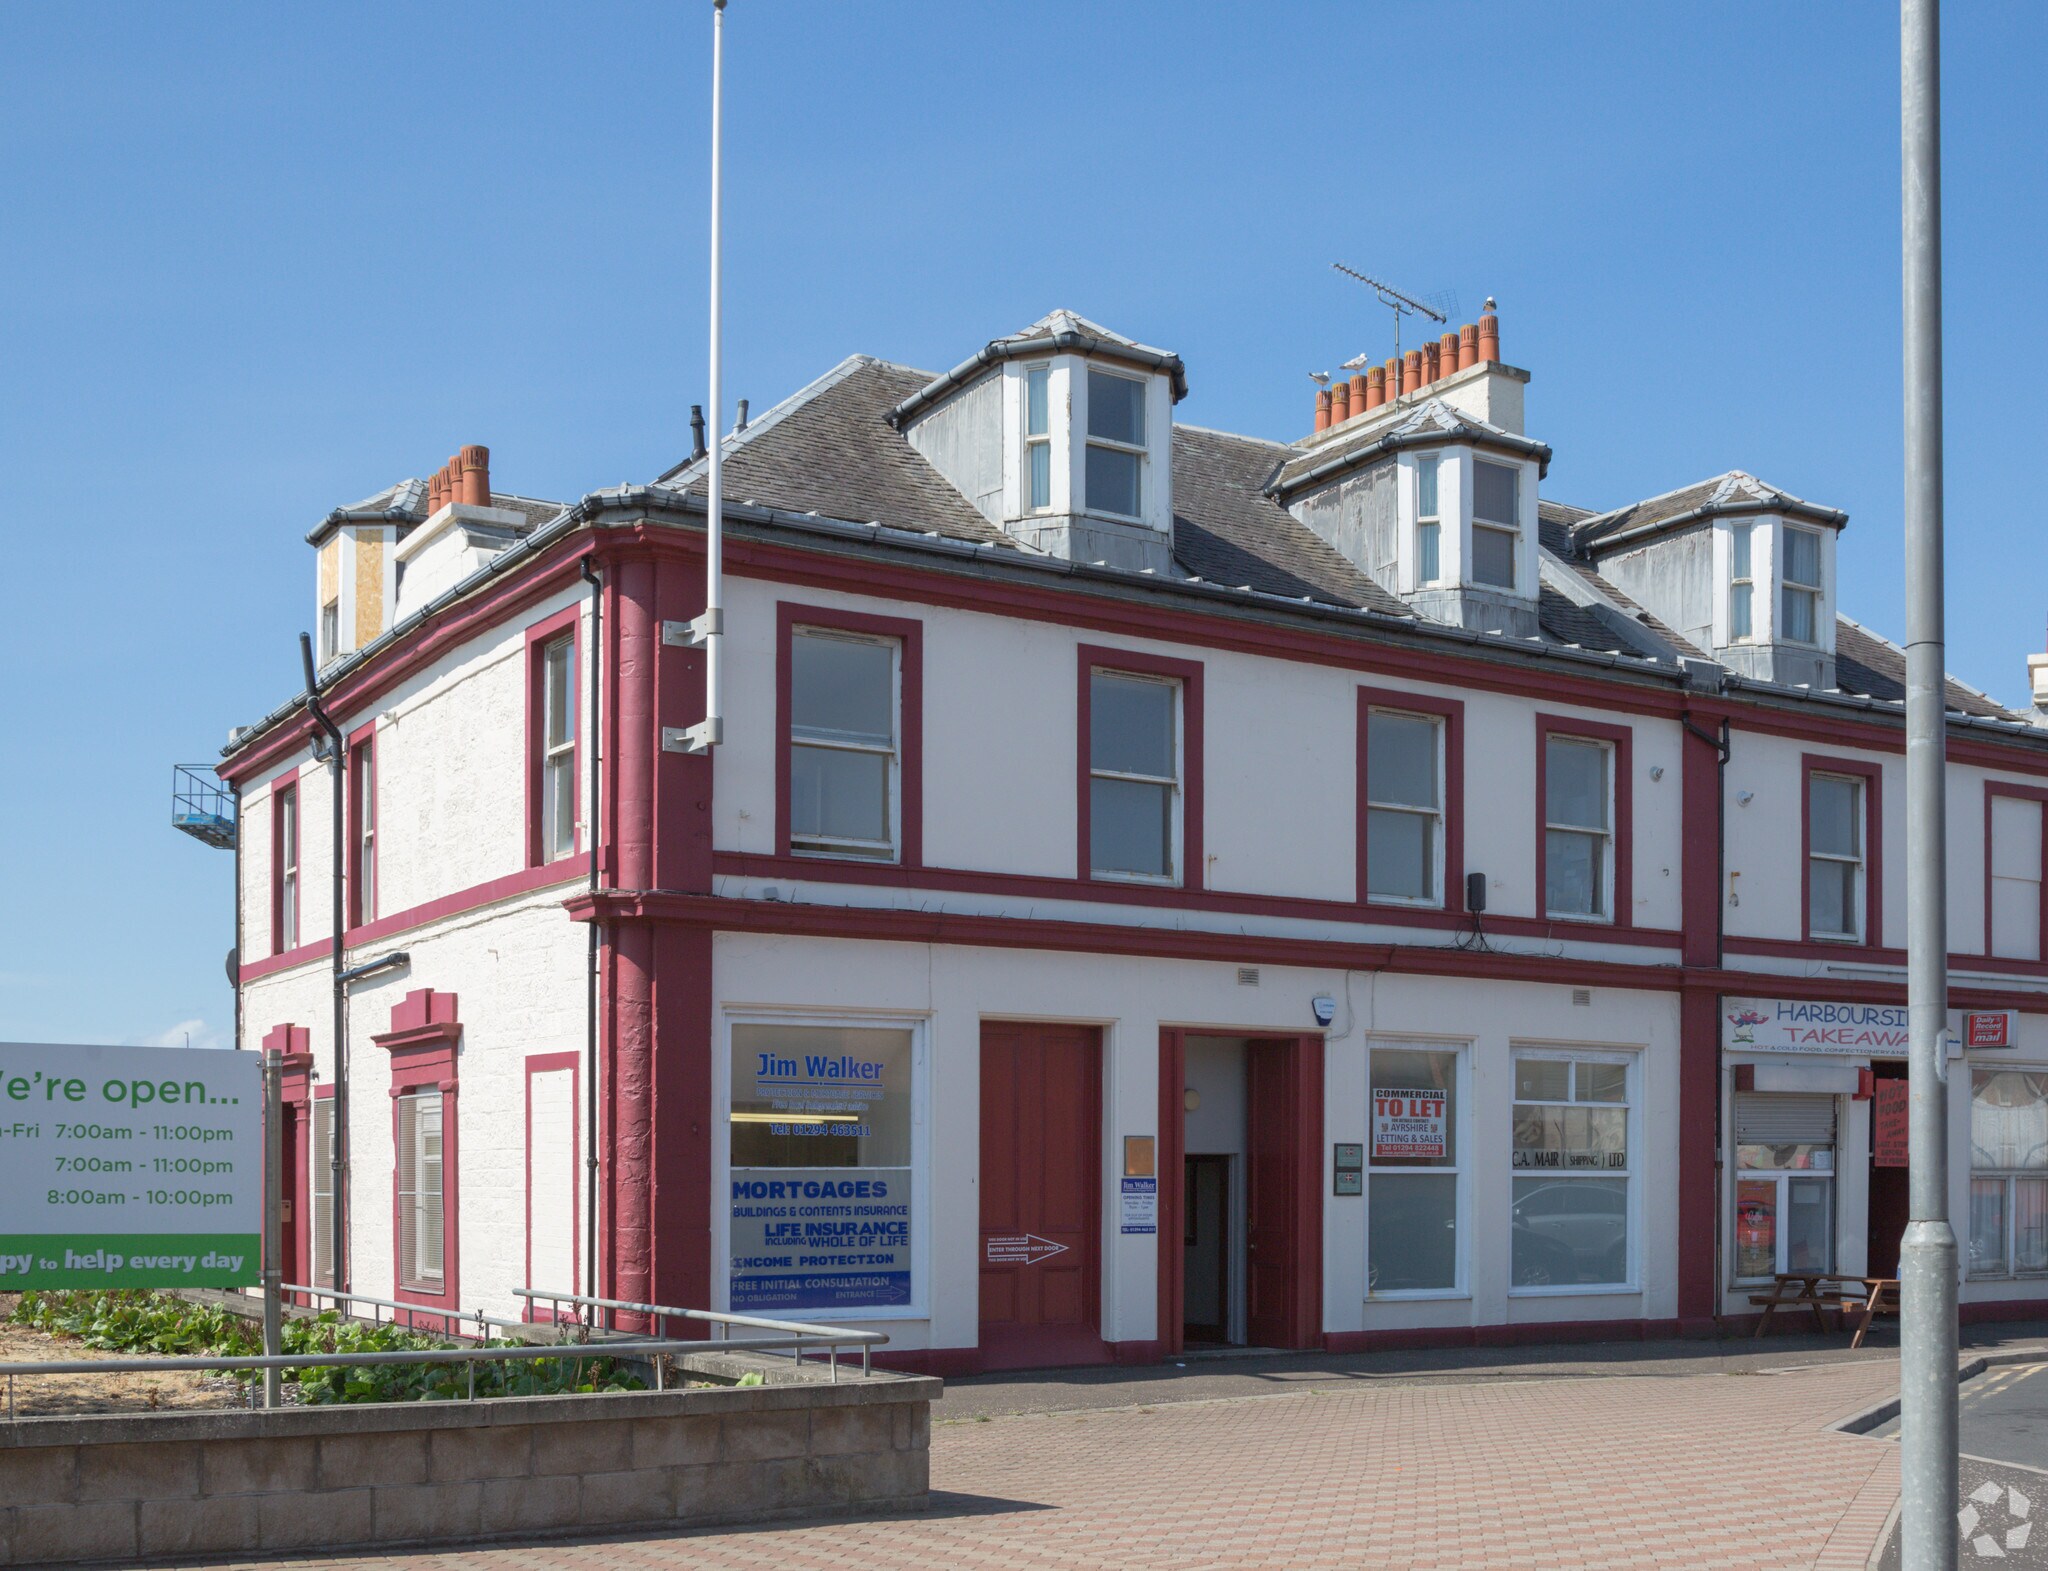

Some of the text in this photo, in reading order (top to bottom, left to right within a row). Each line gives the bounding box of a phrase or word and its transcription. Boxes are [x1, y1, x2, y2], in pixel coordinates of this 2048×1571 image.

[1777, 1002, 1909, 1027] HARBOURSI
[1975, 1031, 2001, 1042] mail
[1824, 1047, 1890, 1055] CONFECTIONERY
[757, 1053, 884, 1080] Jim Walker
[0, 1070, 240, 1110] e're open...
[1376, 1089, 1445, 1099] COMMERCIAL
[1375, 1098, 1445, 1118] TO LET
[55, 1124, 132, 1140] 7:00am
[153, 1126, 233, 1143] 11:00pm
[770, 1123, 871, 1137] Tel: 01294 463511
[1391, 1124, 1429, 1133] AYRSHIRE
[1376, 1134, 1443, 1144] LETTING & SALES
[55, 1157, 132, 1173] 7:00am
[153, 1158, 234, 1176] 11:00pm
[1512, 1151, 1530, 1167] C.A.
[1534, 1151, 1560, 1167] MAIR
[1569, 1155, 1598, 1166] SHIPPING
[1608, 1152, 1625, 1167] LTD
[732, 1181, 888, 1200] MORTGAGES
[47, 1190, 126, 1205] 8:00am
[146, 1190, 234, 1207] 10:00pm
[733, 1205, 908, 1218] BUILDINGS & CONTENTS INSURANCE
[765, 1222, 908, 1237] LIFE INSURANCE
[765, 1235, 908, 1248] INCLUDING WHOLE OF LIFE
[39, 1257, 58, 1270] to
[64, 1249, 124, 1273] help
[129, 1255, 197, 1274] every
[201, 1251, 245, 1273] day
[733, 1254, 895, 1269] INCOME PROTECTION
[731, 1276, 890, 1291] FREE INITIAL CONSULTATION
[732, 1293, 797, 1303] NO OBLIGATION
[835, 1290, 875, 1299] ENTRANCE
